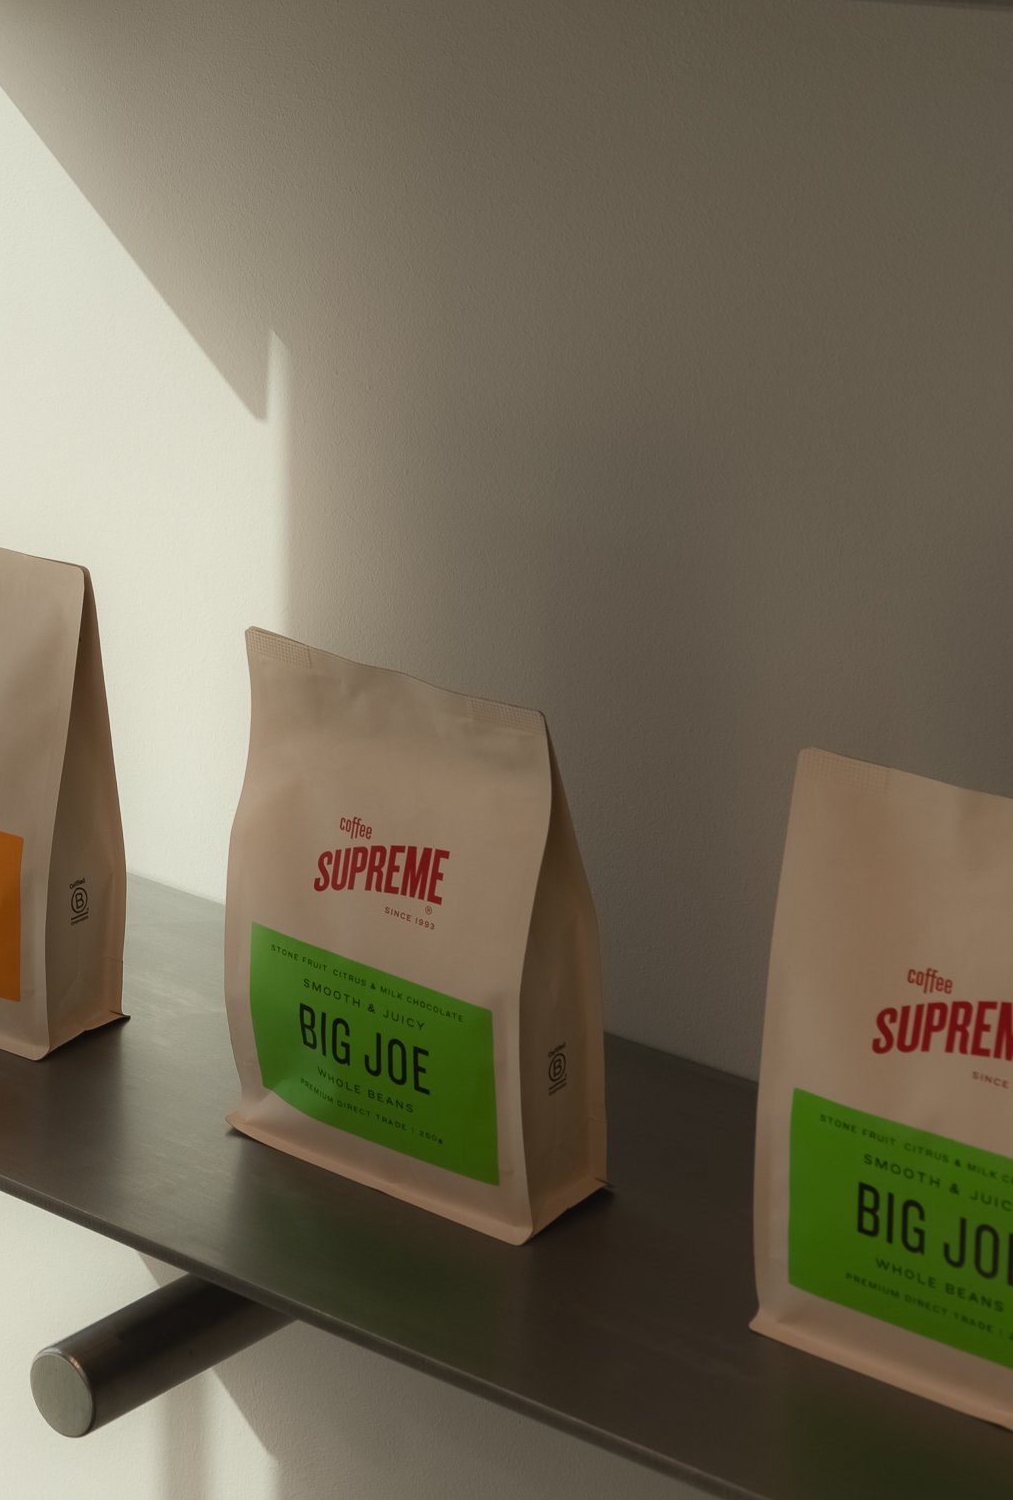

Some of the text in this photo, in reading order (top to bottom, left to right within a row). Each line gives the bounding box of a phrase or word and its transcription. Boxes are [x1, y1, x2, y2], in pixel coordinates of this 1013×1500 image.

[340, 816, 372, 840] coffee
[313, 845, 450, 906] SUPREME
[384, 906, 436, 931] SINCE 1993
[271, 943, 299, 962] STONE
[332, 968, 367, 987] CITRUS
[370, 982, 376, 990] &
[380, 985, 403, 1001] MILK
[406, 995, 464, 1023] CHOCOLATE
[303, 978, 426, 1031] SMOOTH & JUICY
[907, 967, 953, 995] coffee
[299, 1002, 430, 1096] BIG JOE
[300, 1077, 334, 1103] PREMIUM
[337, 1099, 371, 1117] DIRECT
[376, 1113, 407, 1132] TRADE
[317, 1066, 414, 1114] WHOLE BEANS
[972, 1070, 1010, 1089] SINCE
[820, 1113, 857, 1134] STONE
[903, 1142, 949, 1164] CITRUS
[954, 1159, 962, 1168] &
[967, 1162, 997, 1179] MILK
[863, 1153, 940, 1188] SMOOTH
[949, 1183, 960, 1195] &
[857, 1181, 1013, 1286] BIG JO
[845, 1272, 900, 1299] PREMIUM
[905, 1294, 948, 1317] DIRECT
[954, 1312, 993, 1333] TRADE
[875, 1257, 1004, 1313] WHOLE BEANS
